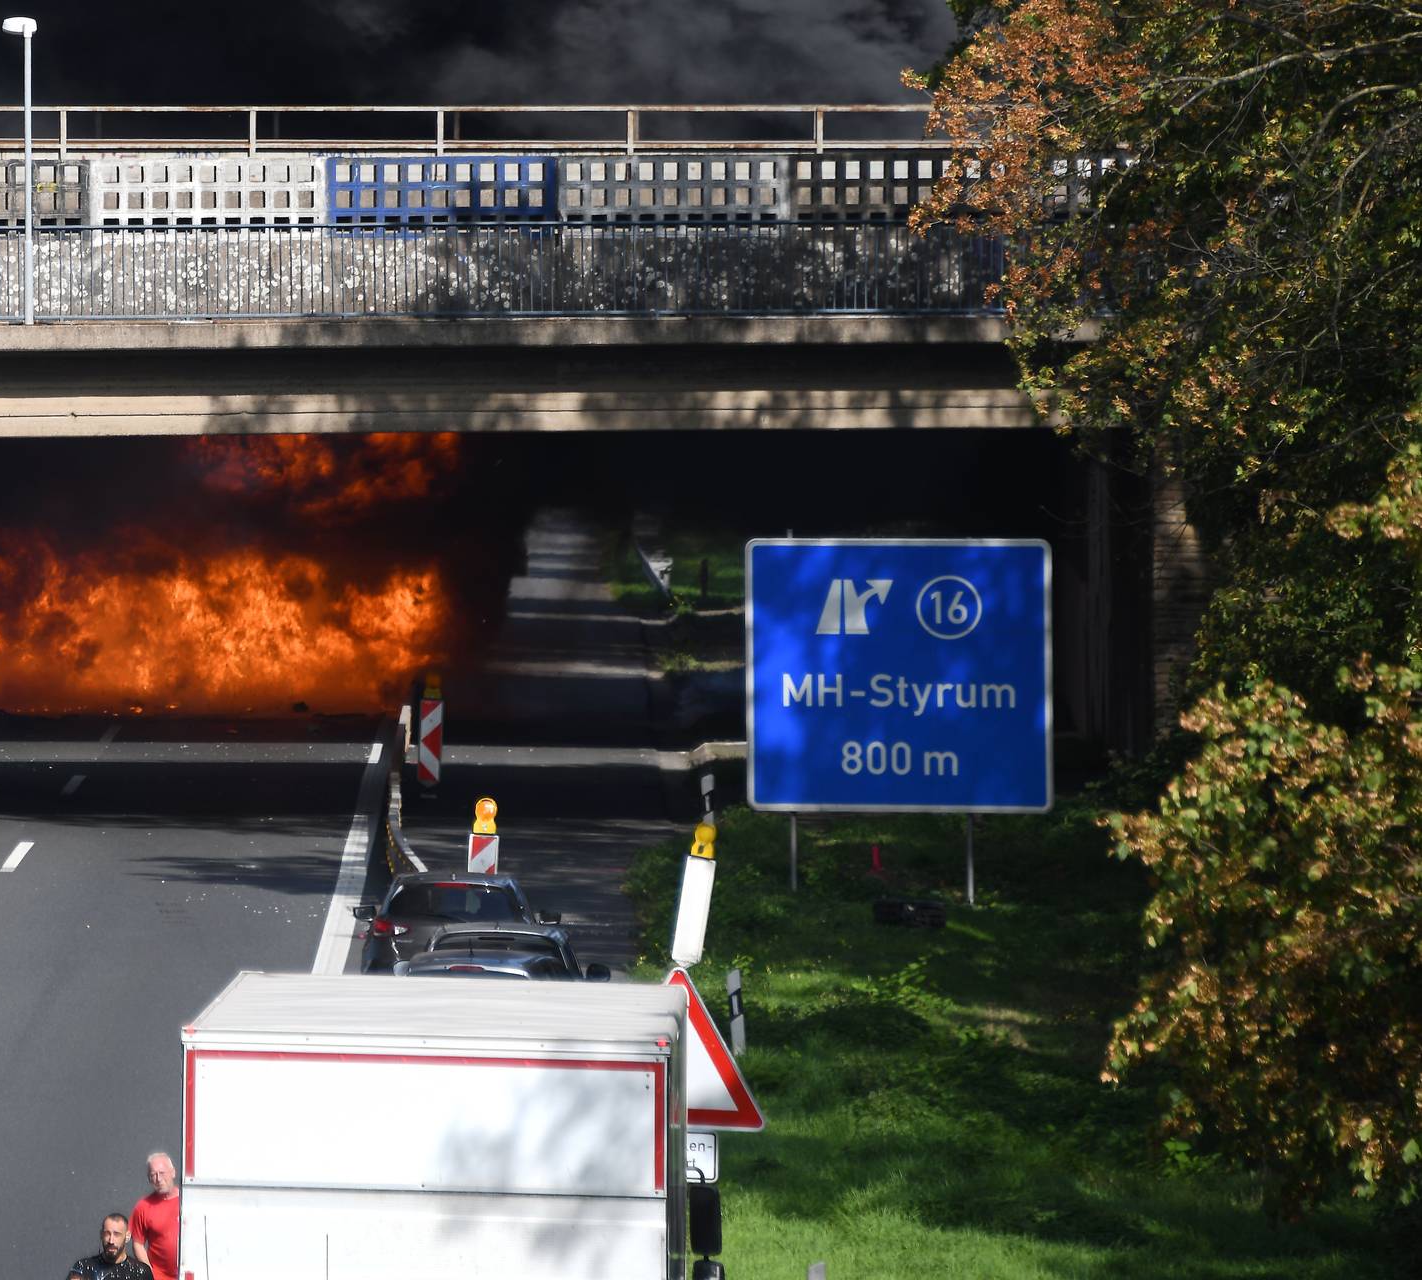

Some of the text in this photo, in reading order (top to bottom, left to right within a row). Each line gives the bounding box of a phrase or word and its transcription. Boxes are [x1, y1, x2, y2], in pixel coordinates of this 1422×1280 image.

[930, 591, 969, 625] 16
[782, 673, 1017, 717] MH-Styrum
[841, 741, 959, 776] 800 m
[687, 1141, 713, 1152] en-
